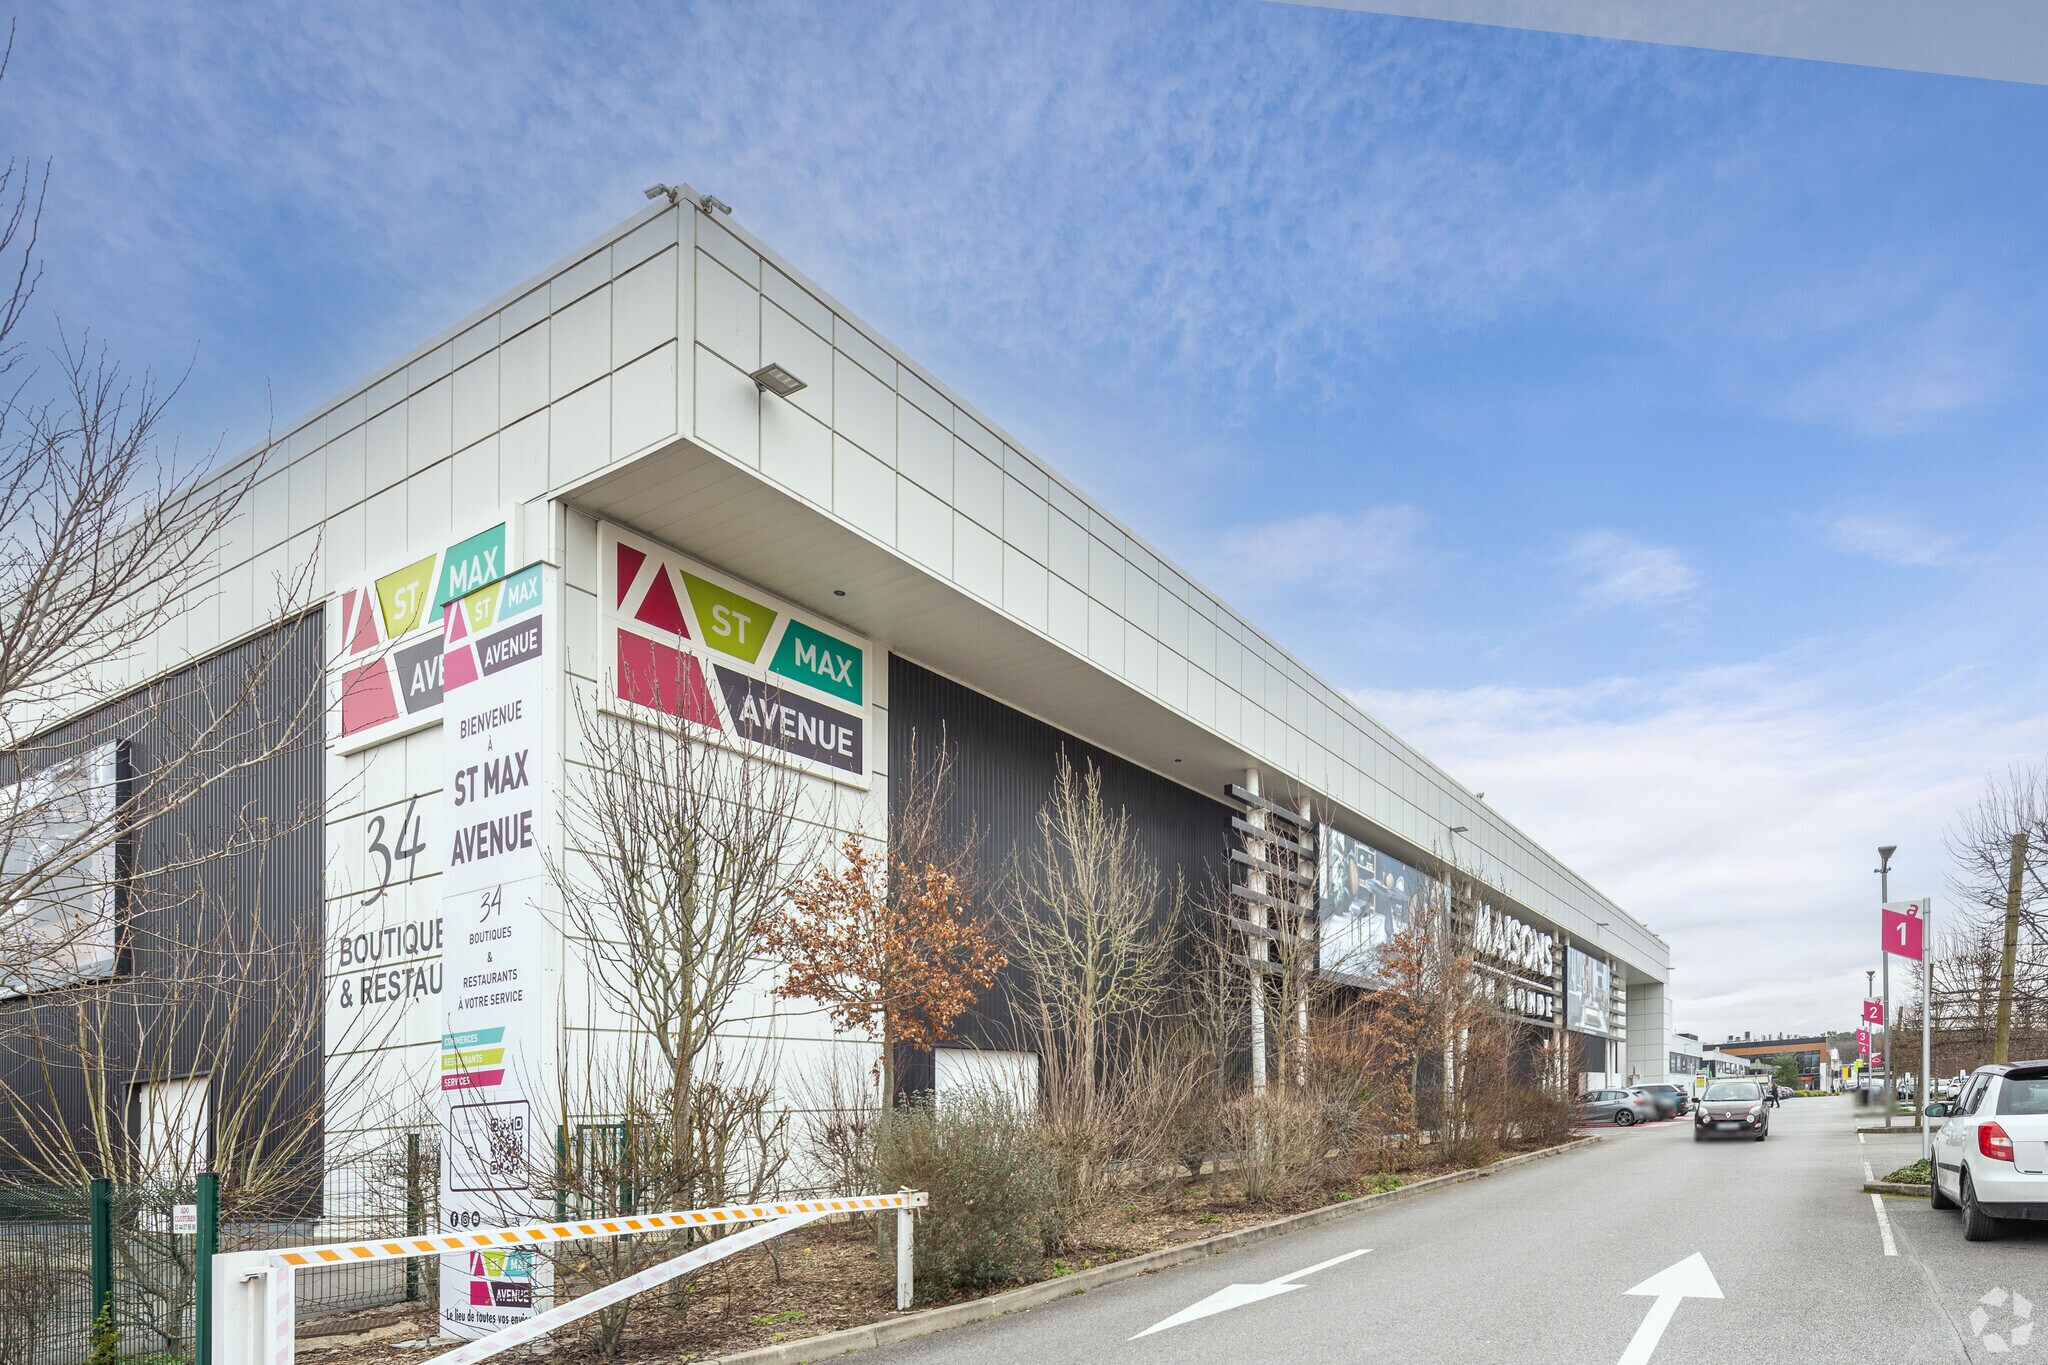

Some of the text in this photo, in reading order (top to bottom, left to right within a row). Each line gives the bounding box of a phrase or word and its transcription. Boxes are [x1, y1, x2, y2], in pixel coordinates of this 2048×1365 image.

[394, 545, 498, 620] ST MAX
[474, 576, 538, 622] ST MAX
[484, 627, 538, 668] AVENUE
[711, 604, 854, 688] ST MAX
[460, 699, 522, 739] BIENVENUE
[738, 693, 854, 758] AVENUE
[487, 735, 493, 751] À
[454, 749, 529, 807] ST MAX
[451, 810, 533, 867] AVENUE
[361, 794, 427, 907] 34
[479, 884, 502, 923] 34
[469, 926, 512, 945] BOUTIQUES
[1473, 900, 1553, 977] MAISONS
[1896, 921, 1907, 946] 1
[487, 951, 493, 963] &
[340, 963, 443, 1009] & RESTAU
[463, 968, 518, 988] RESTAURANTS
[458, 990, 523, 1010] À VOTRE SERVICE
[1869, 1006, 1878, 1019] 2
[444, 1033, 479, 1047] COMMERCES
[1859, 1032, 1866, 1041] 3
[443, 1053, 483, 1067] RESTAURANTS
[443, 1076, 470, 1087] SERVICES
[489, 1257, 500, 1271] ST
[496, 1288, 530, 1303] AVENUE
[446, 1308, 453, 1320] Le
[455, 1308, 465, 1321] lieu
[467, 1309, 475, 1322] de
[476, 1310, 496, 1324] toutes
[498, 1314, 509, 1325] vos
